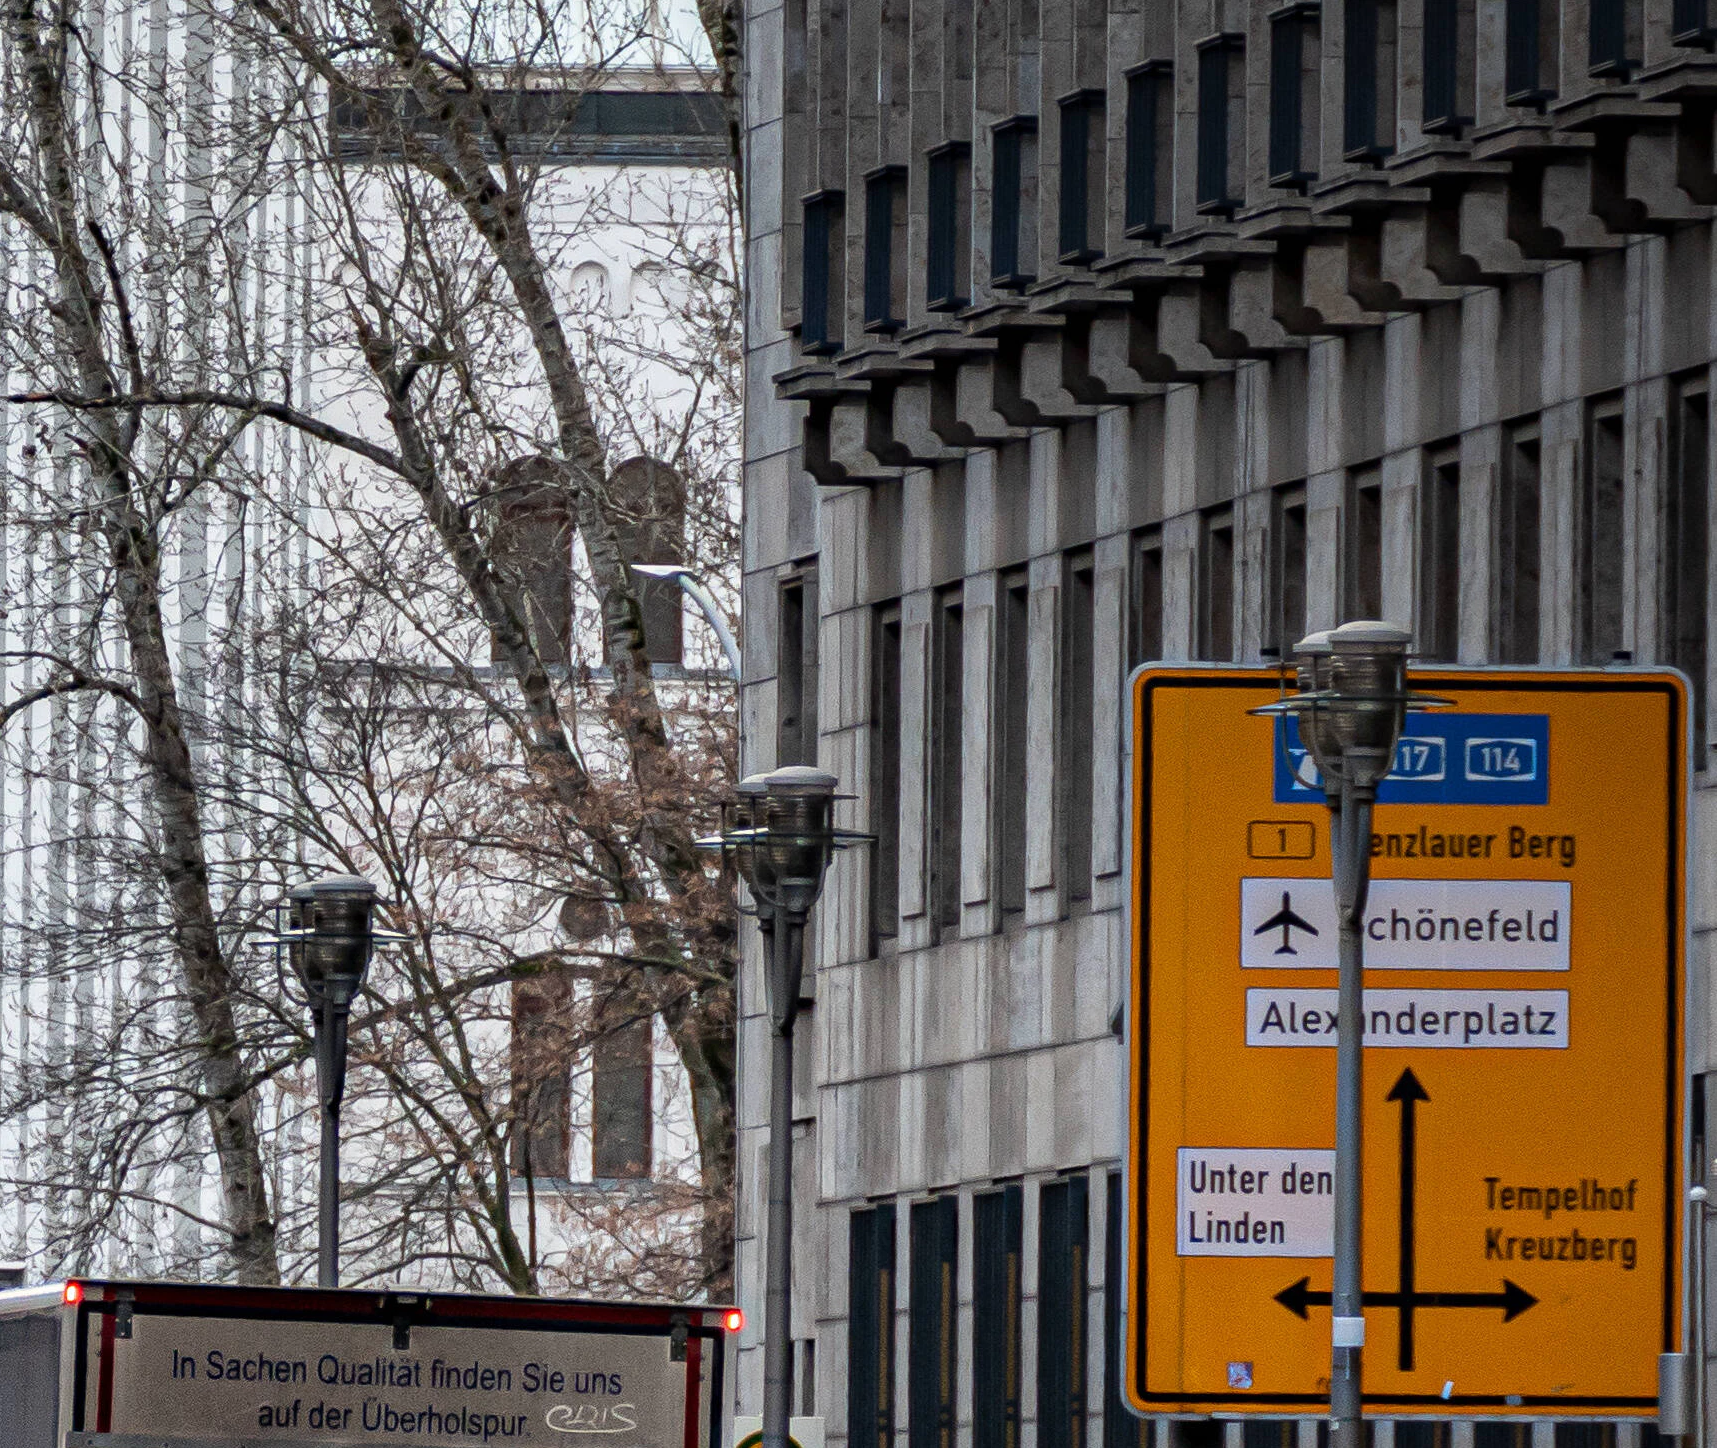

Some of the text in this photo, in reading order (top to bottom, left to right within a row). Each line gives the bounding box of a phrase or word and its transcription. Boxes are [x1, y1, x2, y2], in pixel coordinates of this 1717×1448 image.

[1481, 747, 1520, 771] 114
[1277, 828, 1287, 852] 1
[1370, 826, 1576, 867] enzlauer Berg
[1362, 908, 1559, 942] chönefeld
[1190, 1161, 1333, 1195] Unter den
[1484, 1177, 1638, 1219] Tempelhof
[1189, 1210, 1285, 1244] Linden
[1485, 1227, 1637, 1270] Kreuzberg
[172, 1350, 622, 1395] In Sachen Qualität finden Sie uns
[258, 1399, 532, 1441] auf der Überholspur.
